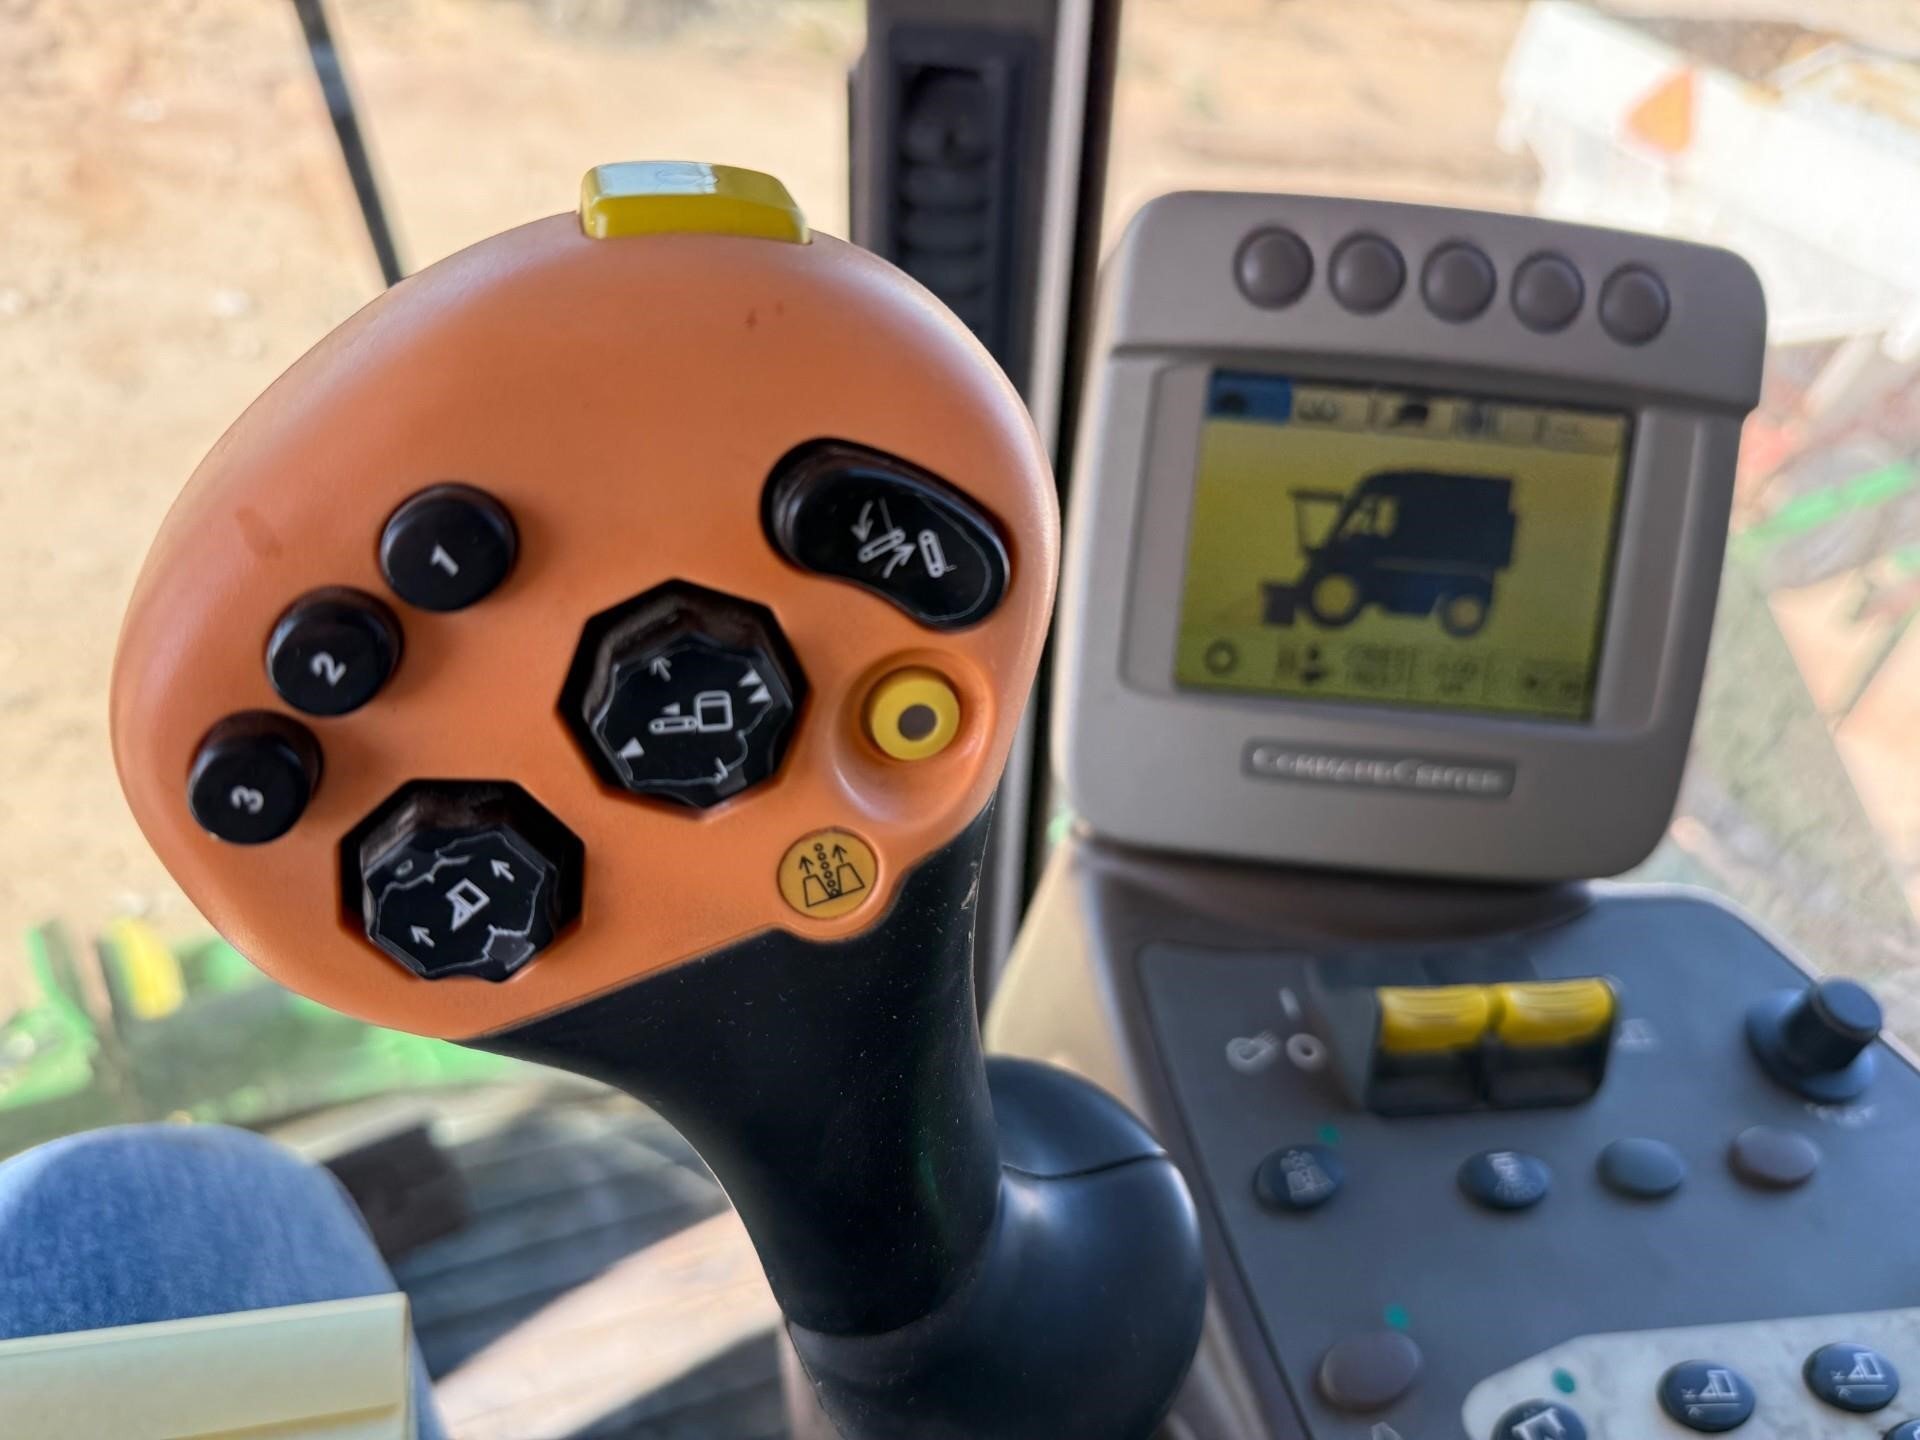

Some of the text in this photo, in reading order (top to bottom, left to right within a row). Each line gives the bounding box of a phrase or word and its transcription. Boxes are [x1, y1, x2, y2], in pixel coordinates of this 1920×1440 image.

[430, 544, 459, 576] 1
[311, 652, 346, 685] 2
[231, 784, 265, 812] 3
